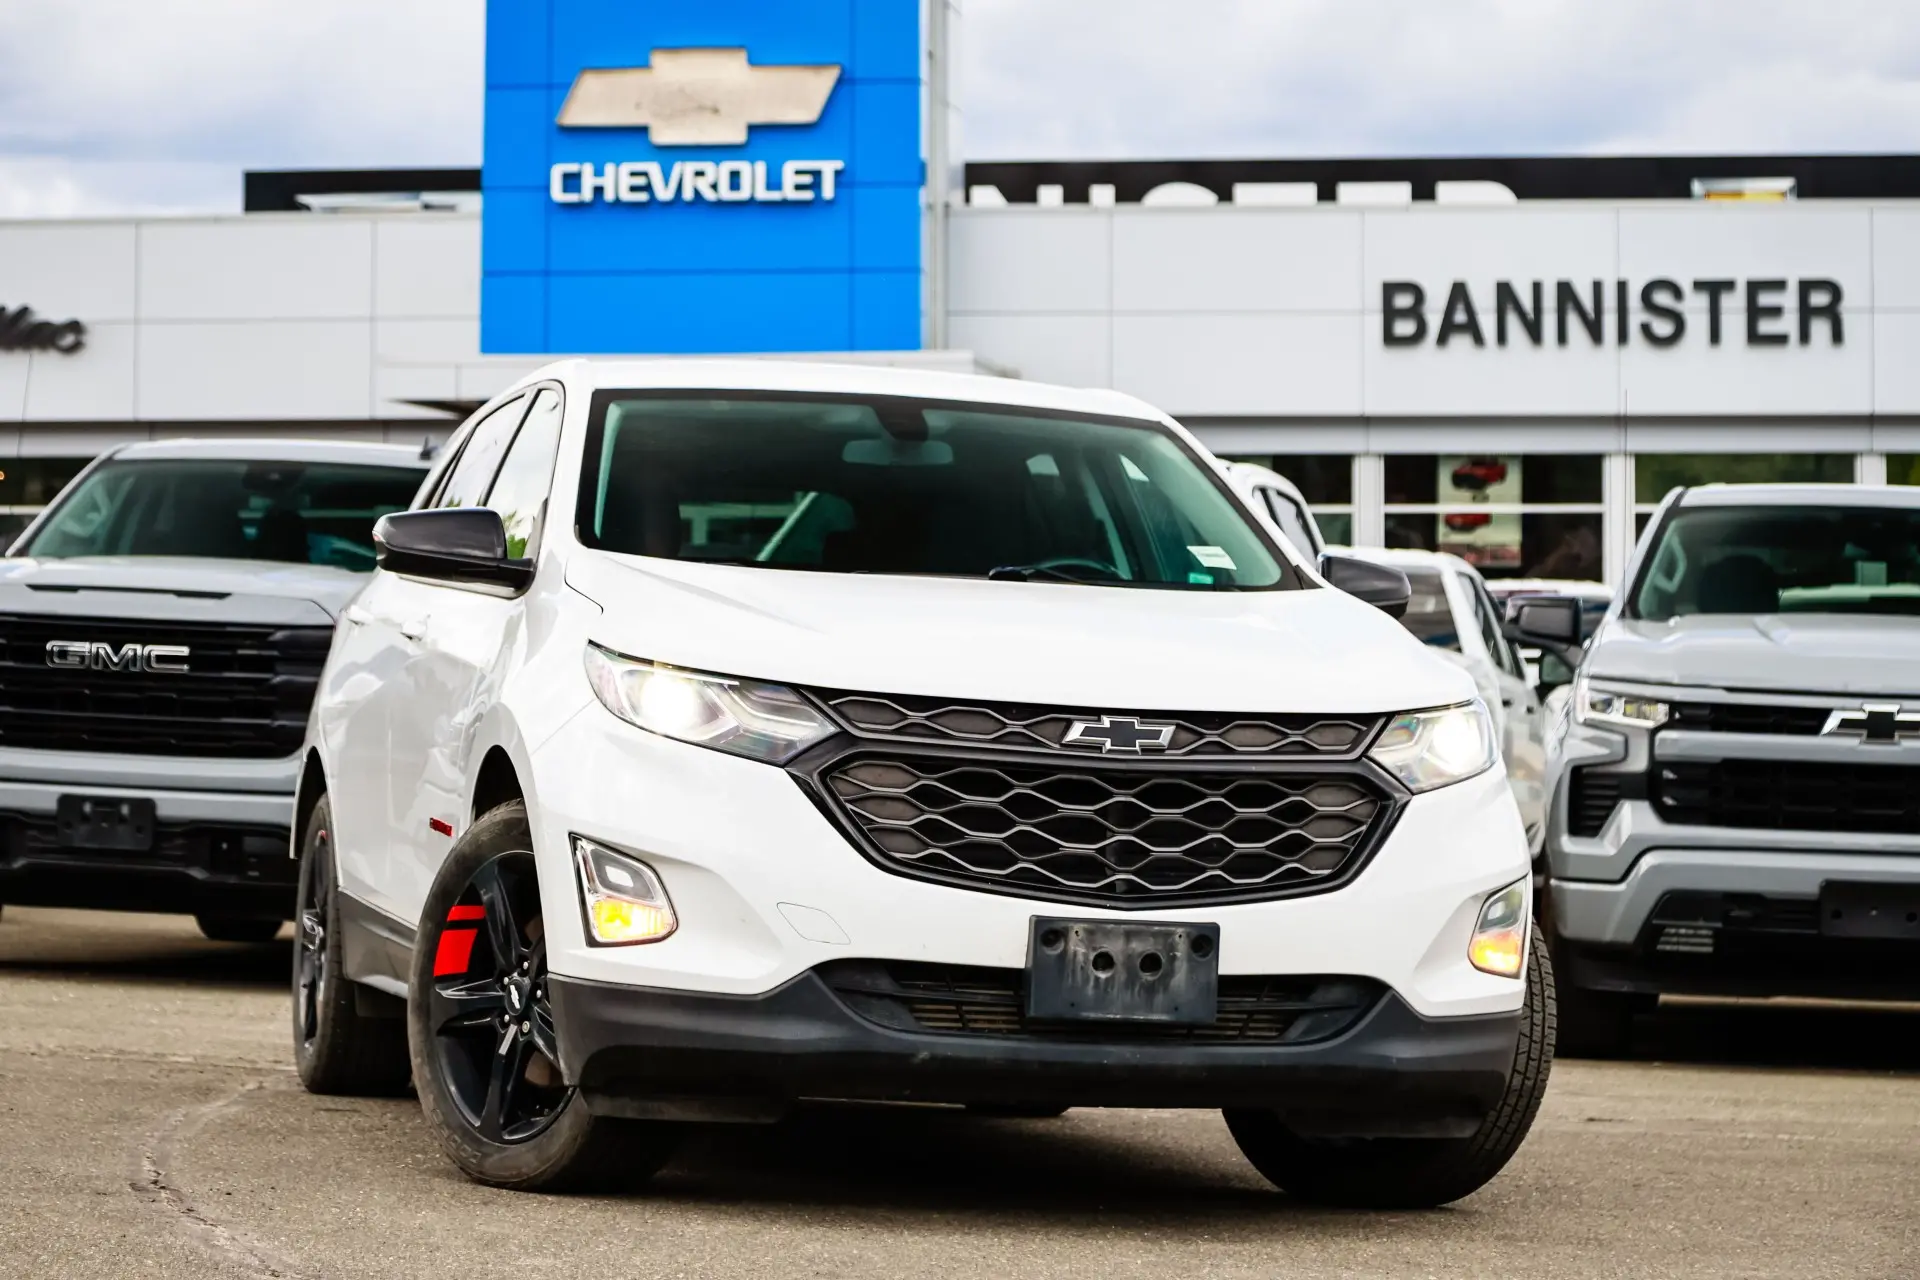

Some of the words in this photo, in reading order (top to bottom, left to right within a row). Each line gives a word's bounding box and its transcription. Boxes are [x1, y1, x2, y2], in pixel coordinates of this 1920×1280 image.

[550, 160, 845, 203] CHEVROLET
[1382, 279, 1845, 346] BANNISTER
[46, 640, 190, 674] GMC
